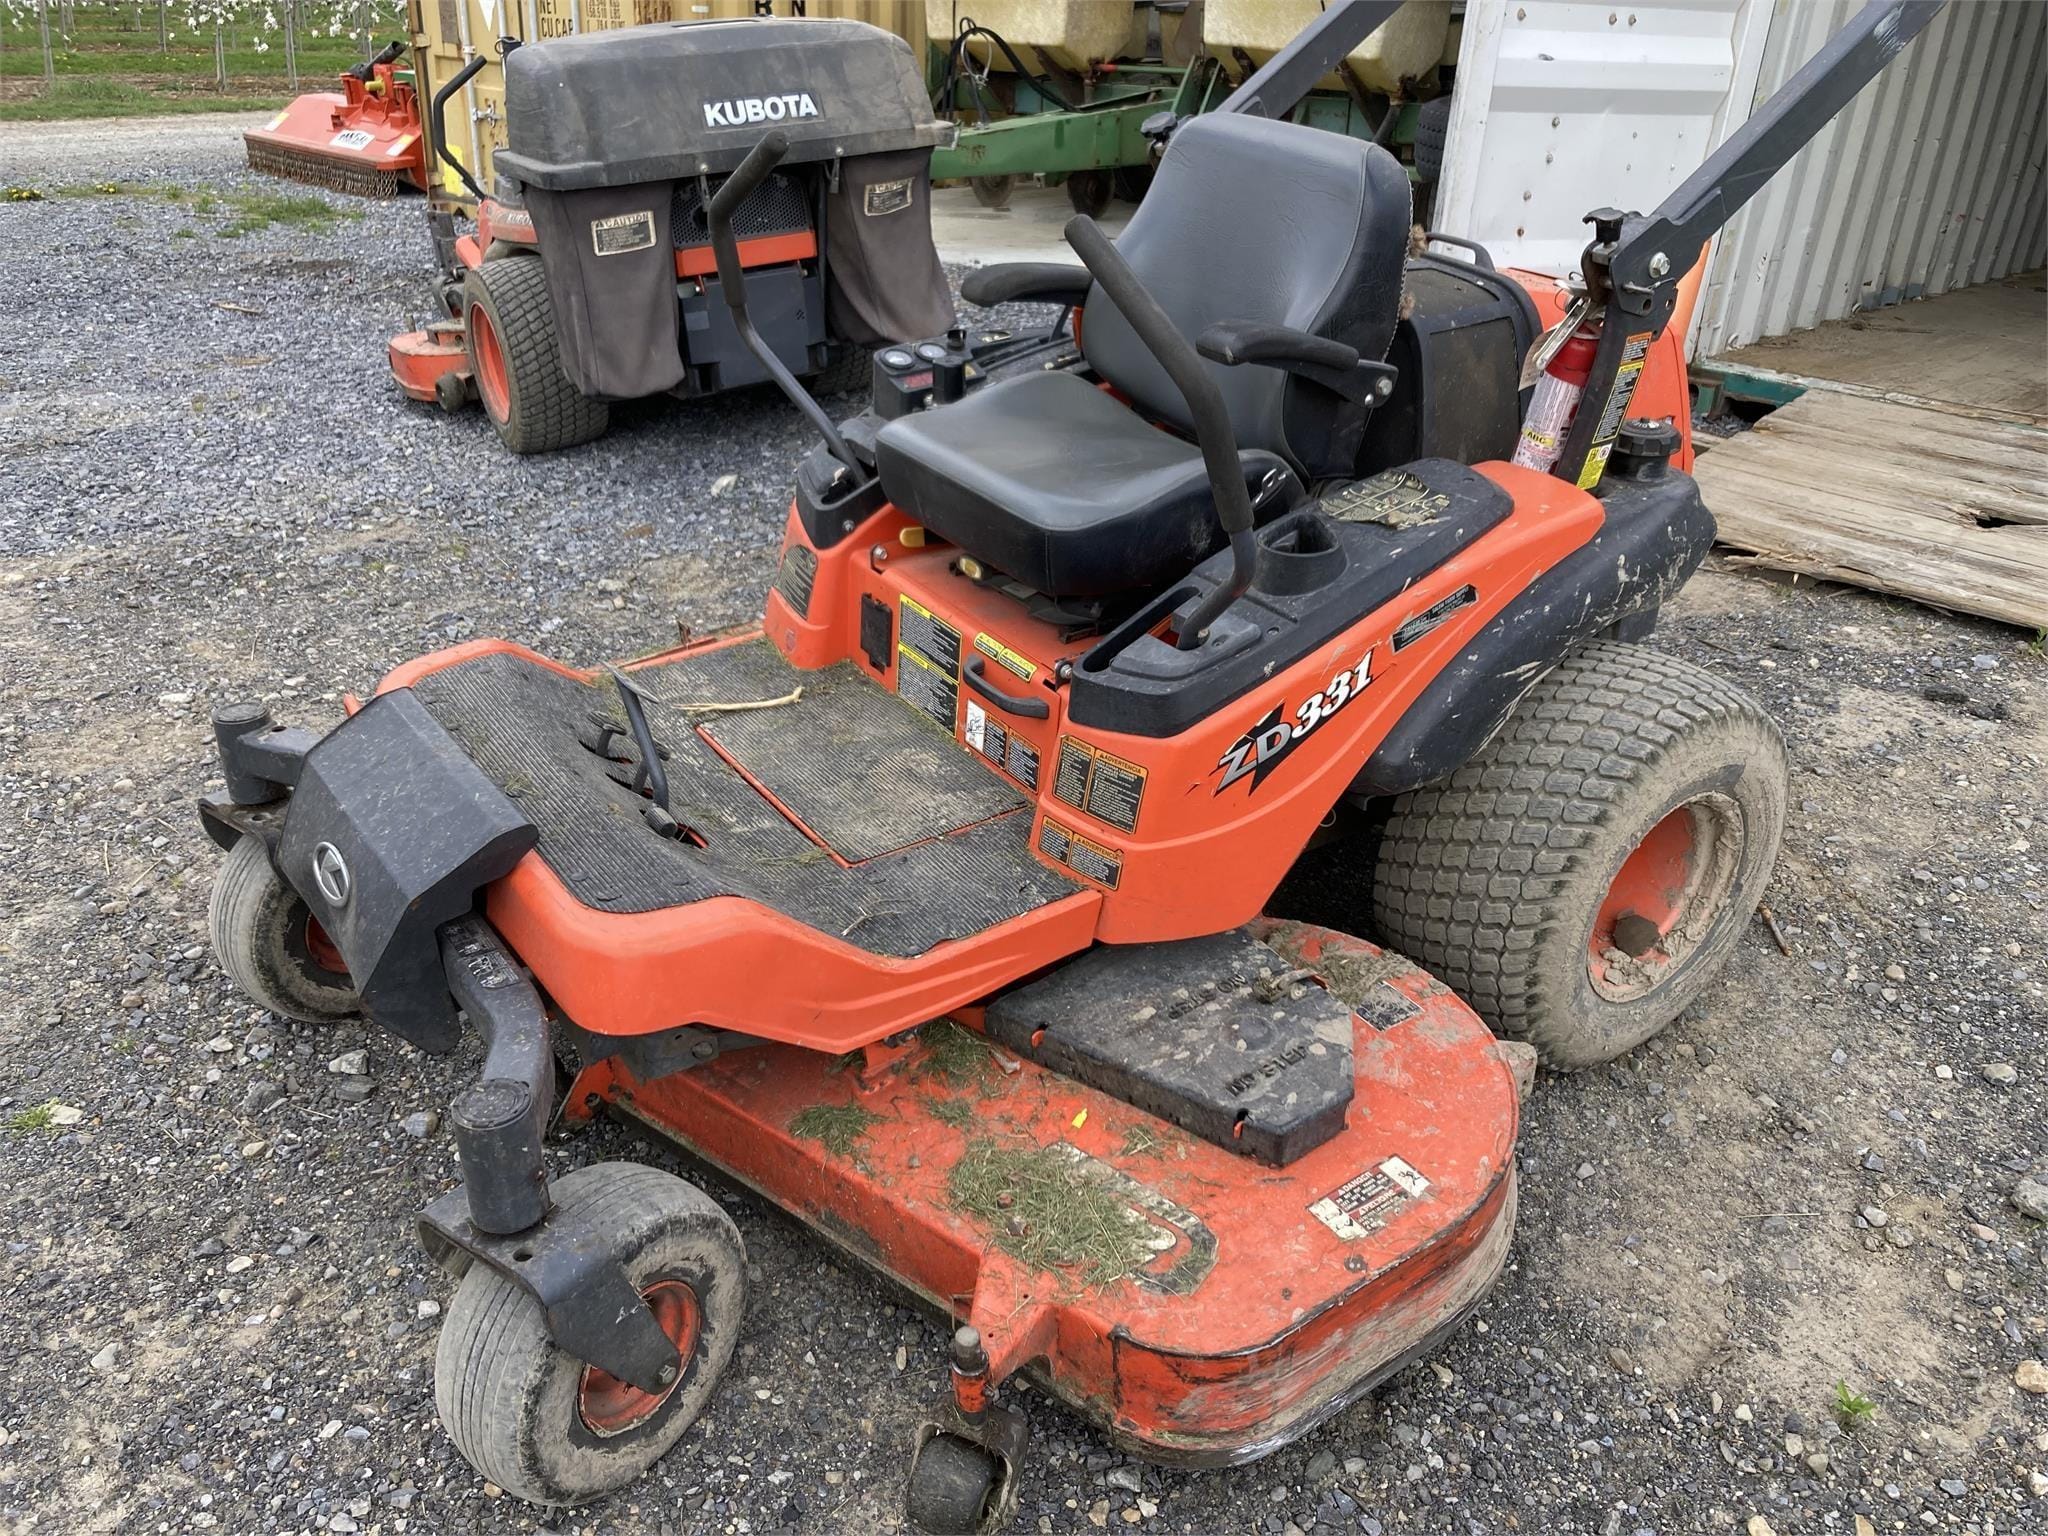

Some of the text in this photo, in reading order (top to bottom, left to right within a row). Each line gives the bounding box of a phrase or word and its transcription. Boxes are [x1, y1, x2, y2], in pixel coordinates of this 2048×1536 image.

[540, 0, 557, 14] NET
[703, 93, 819, 128] KUBOTA
[606, 212, 649, 228] CAUTION
[1216, 650, 1374, 793] ZD331
[1104, 754, 1142, 774] ADVERTENCIA
[1225, 1045, 1307, 1097] NO STEP
[1342, 1171, 1373, 1191] DANGER
